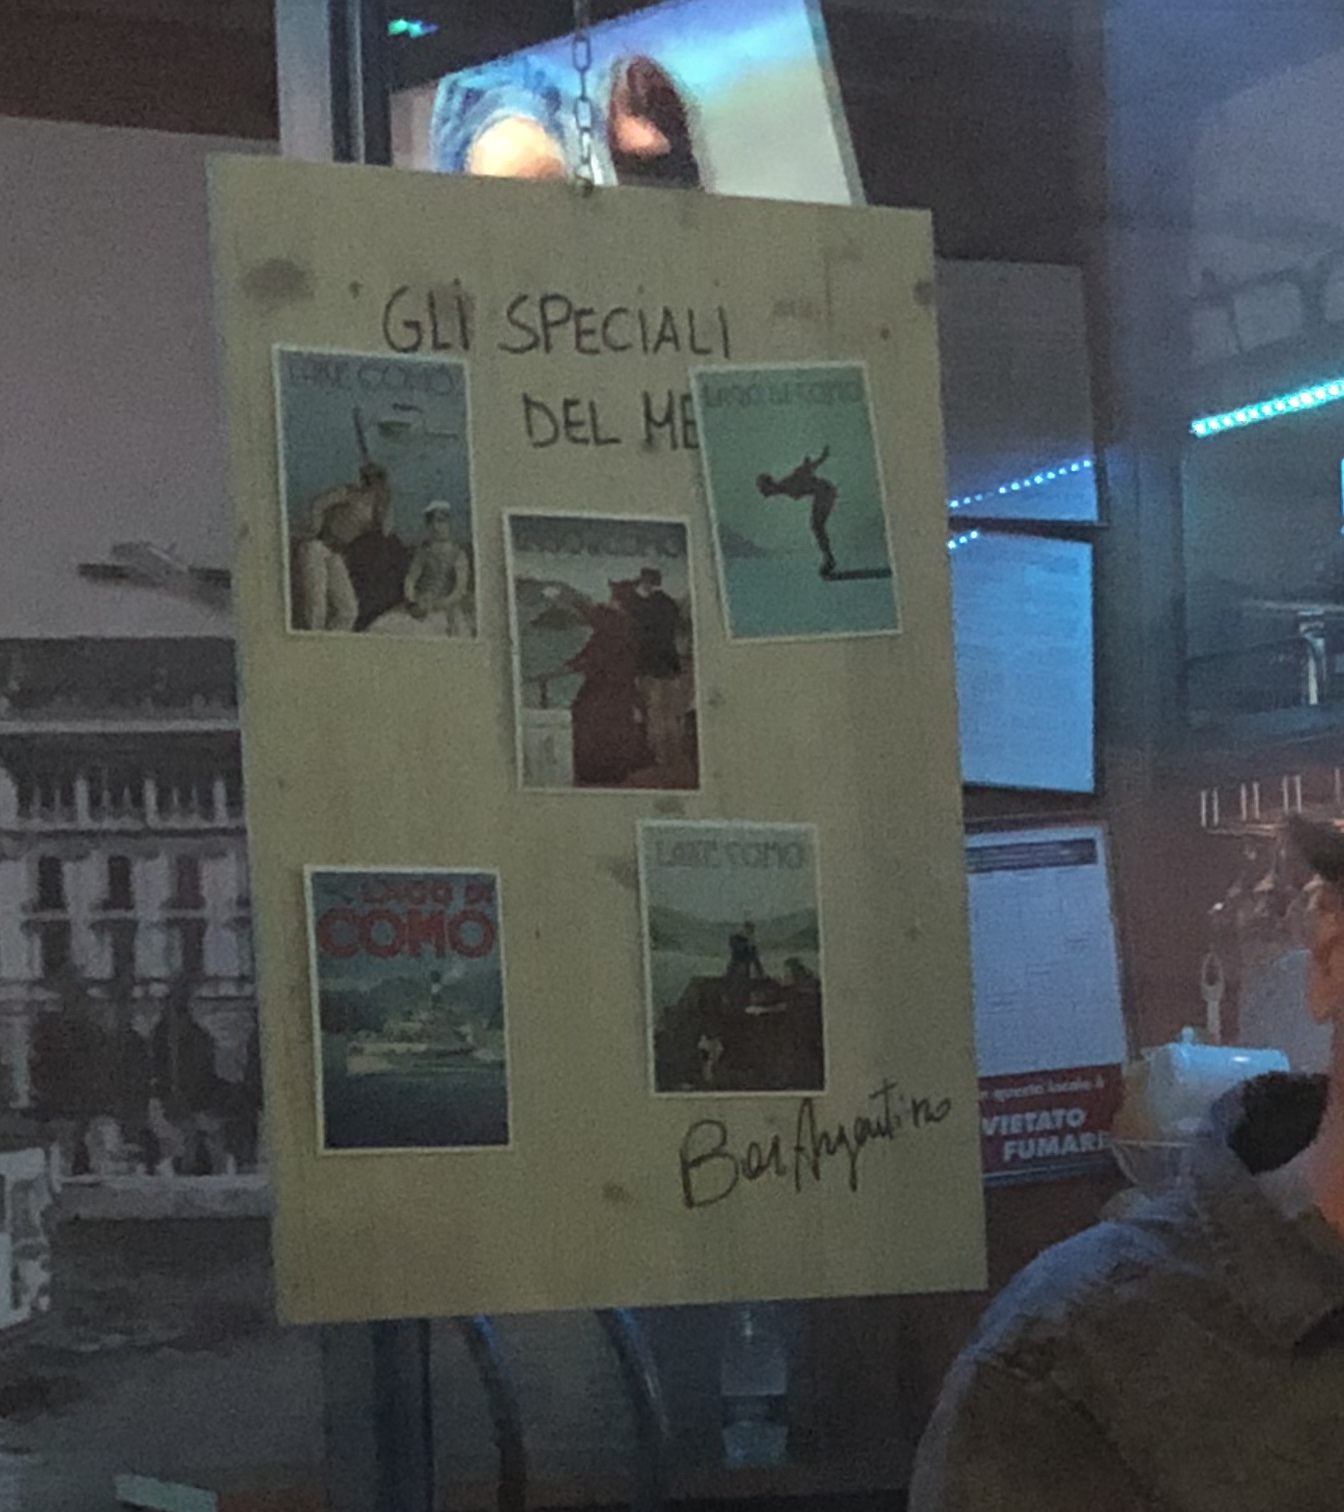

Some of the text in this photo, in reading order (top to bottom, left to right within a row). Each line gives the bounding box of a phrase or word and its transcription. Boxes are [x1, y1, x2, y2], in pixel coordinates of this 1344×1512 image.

[382, 284, 730, 358] GLI SPECIALI
[522, 391, 621, 448] DEL
[726, 841, 806, 869] COMO
[316, 907, 494, 958] COMO
[1048, 1076, 1092, 1094] locale
[982, 1106, 1088, 1136] VIETATO
